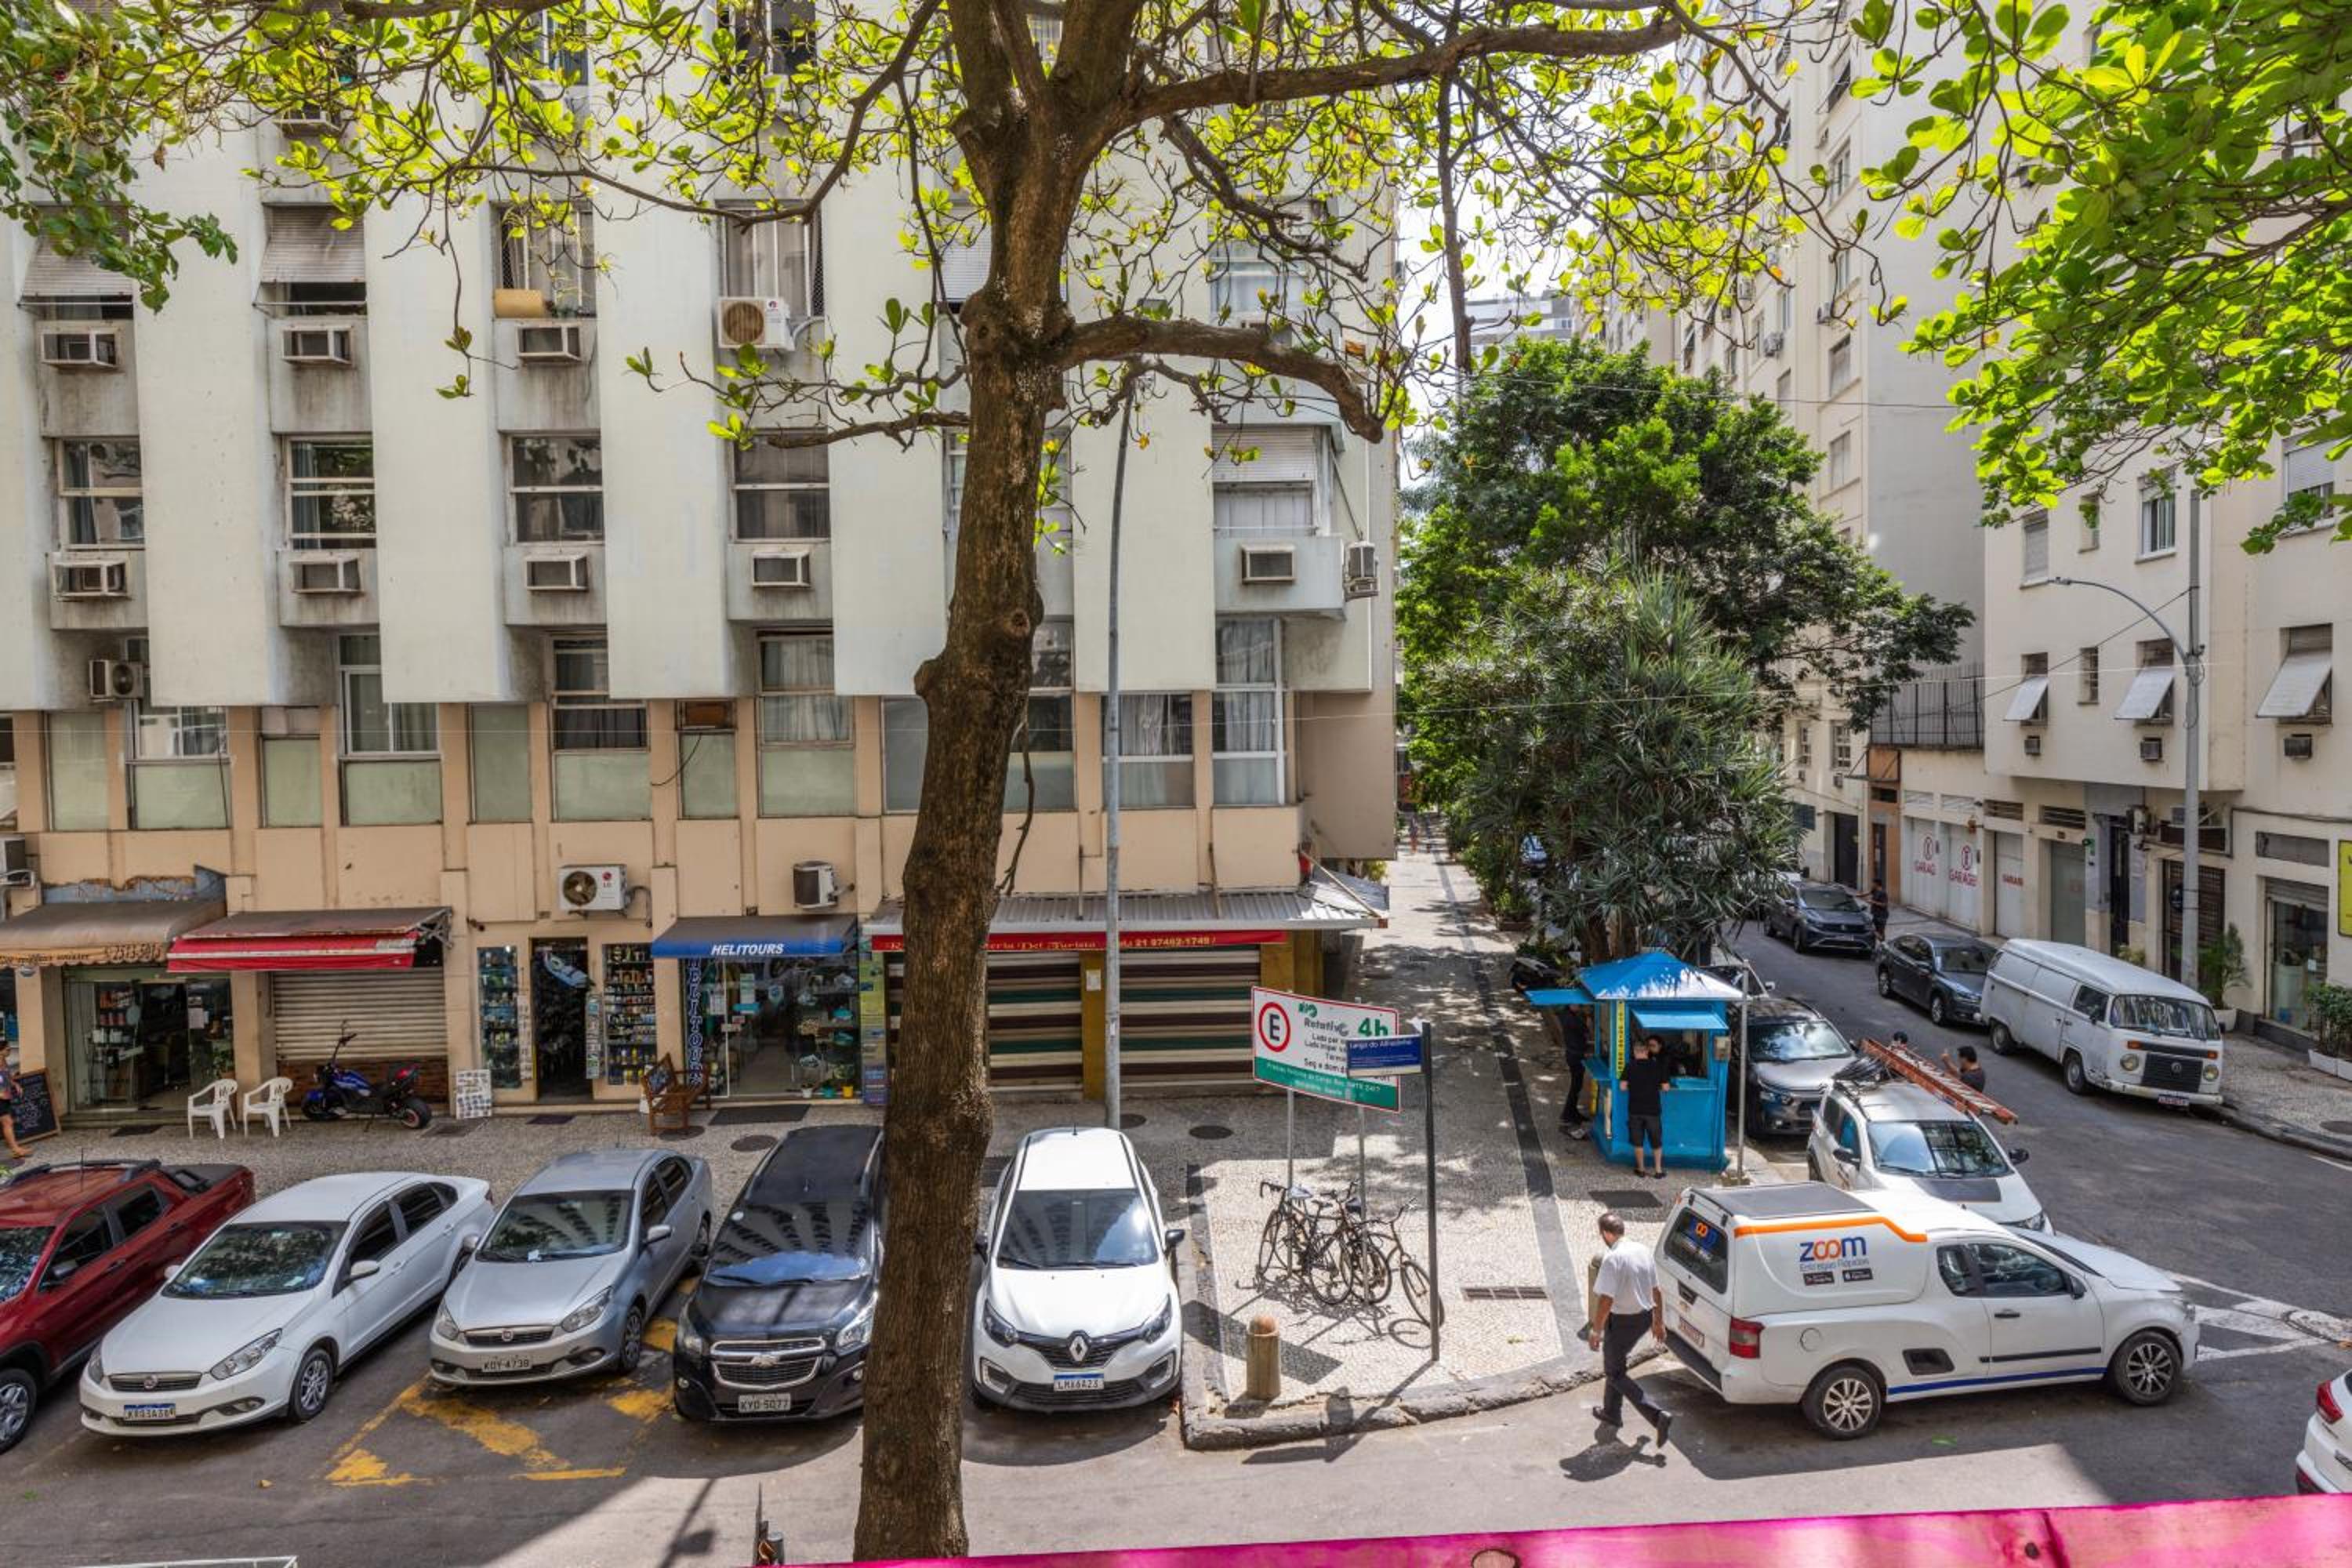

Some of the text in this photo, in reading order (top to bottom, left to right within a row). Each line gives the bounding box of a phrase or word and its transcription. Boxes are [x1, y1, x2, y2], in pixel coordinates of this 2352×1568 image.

[710, 943, 784, 956] HELITOURS
[1269, 1014, 1279, 1042] E
[1358, 1018, 1388, 1036] 4h
[1800, 1237, 1866, 1262] zoom
